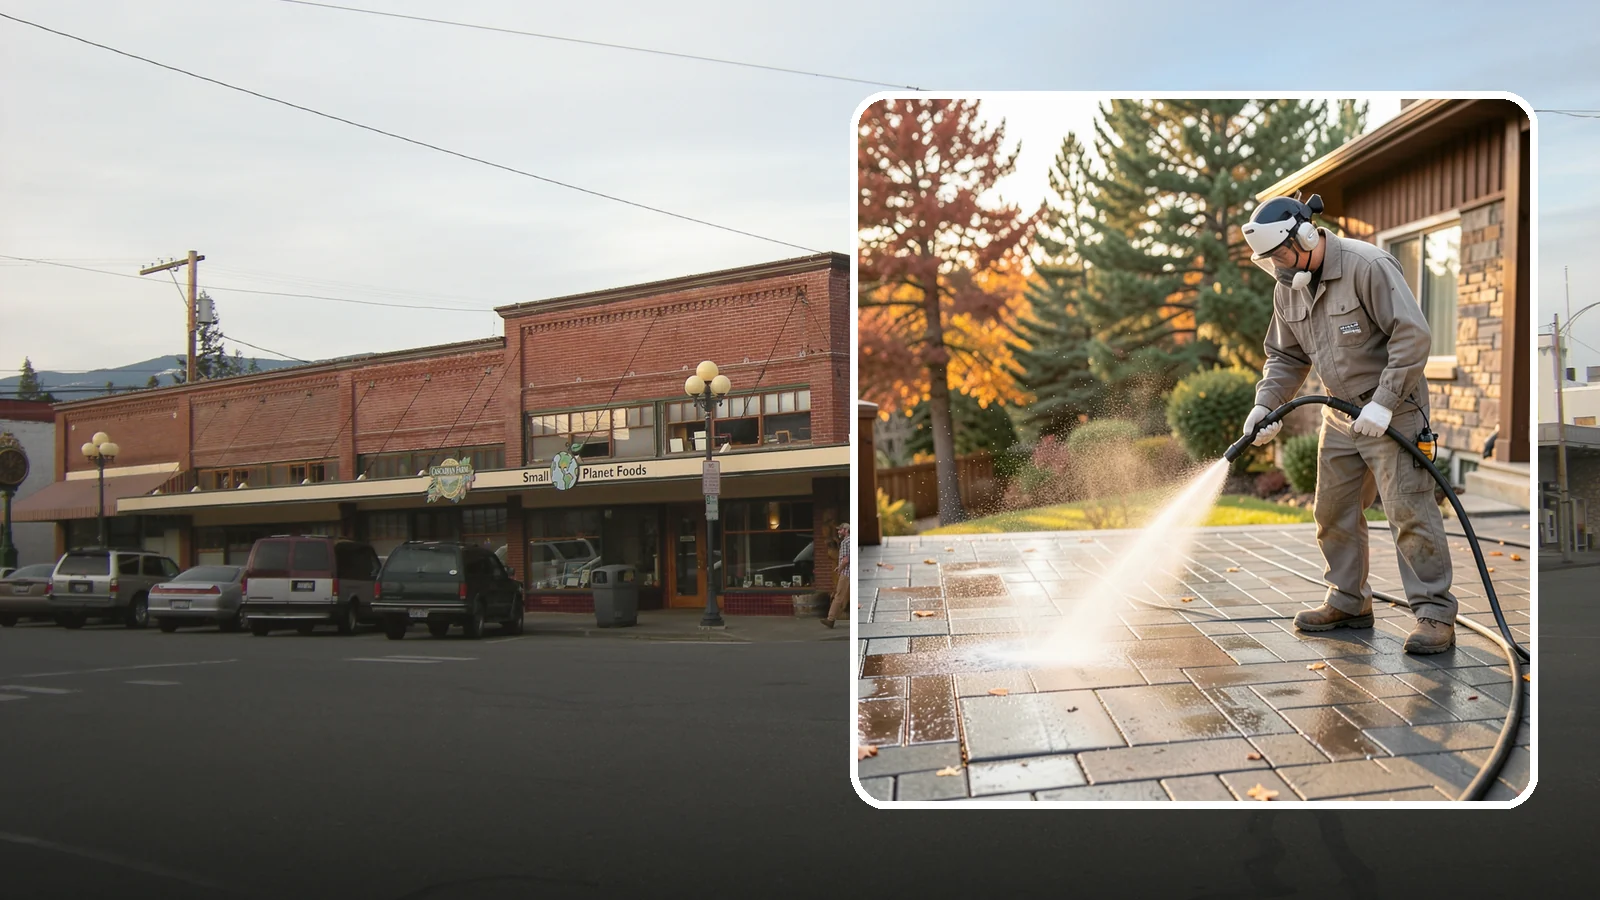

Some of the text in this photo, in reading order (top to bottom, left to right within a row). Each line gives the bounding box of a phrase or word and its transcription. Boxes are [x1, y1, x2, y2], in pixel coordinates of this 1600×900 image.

[431, 466, 456, 476] CASCADIAN
[523, 464, 647, 483] Small Planet Foods
